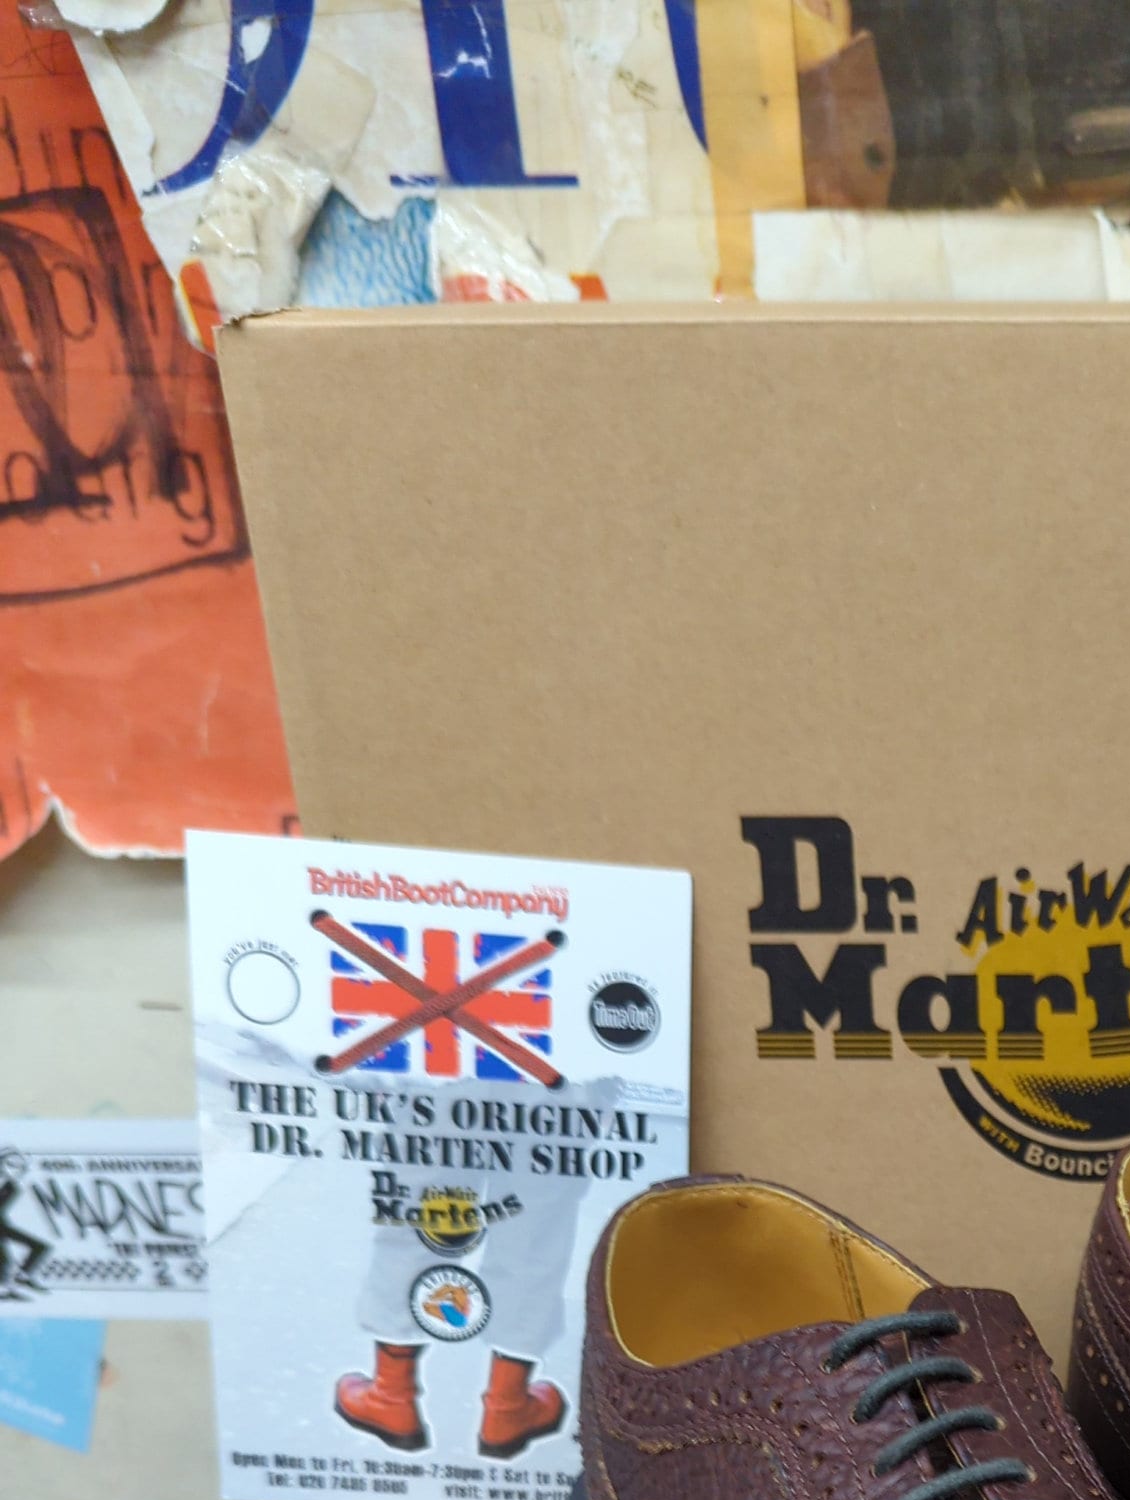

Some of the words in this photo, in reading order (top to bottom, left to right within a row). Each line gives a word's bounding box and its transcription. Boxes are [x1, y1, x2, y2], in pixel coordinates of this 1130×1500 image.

[307, 866, 569, 921] BritishBootCompany
[740, 816, 918, 933] Dr.
[229, 1080, 318, 1118] THE
[334, 1087, 436, 1127] UK'S
[451, 1098, 658, 1144] ORIGINAL
[251, 1121, 322, 1159] DR.
[341, 1127, 515, 1172] MARTEN
[530, 1142, 645, 1180] SHOP
